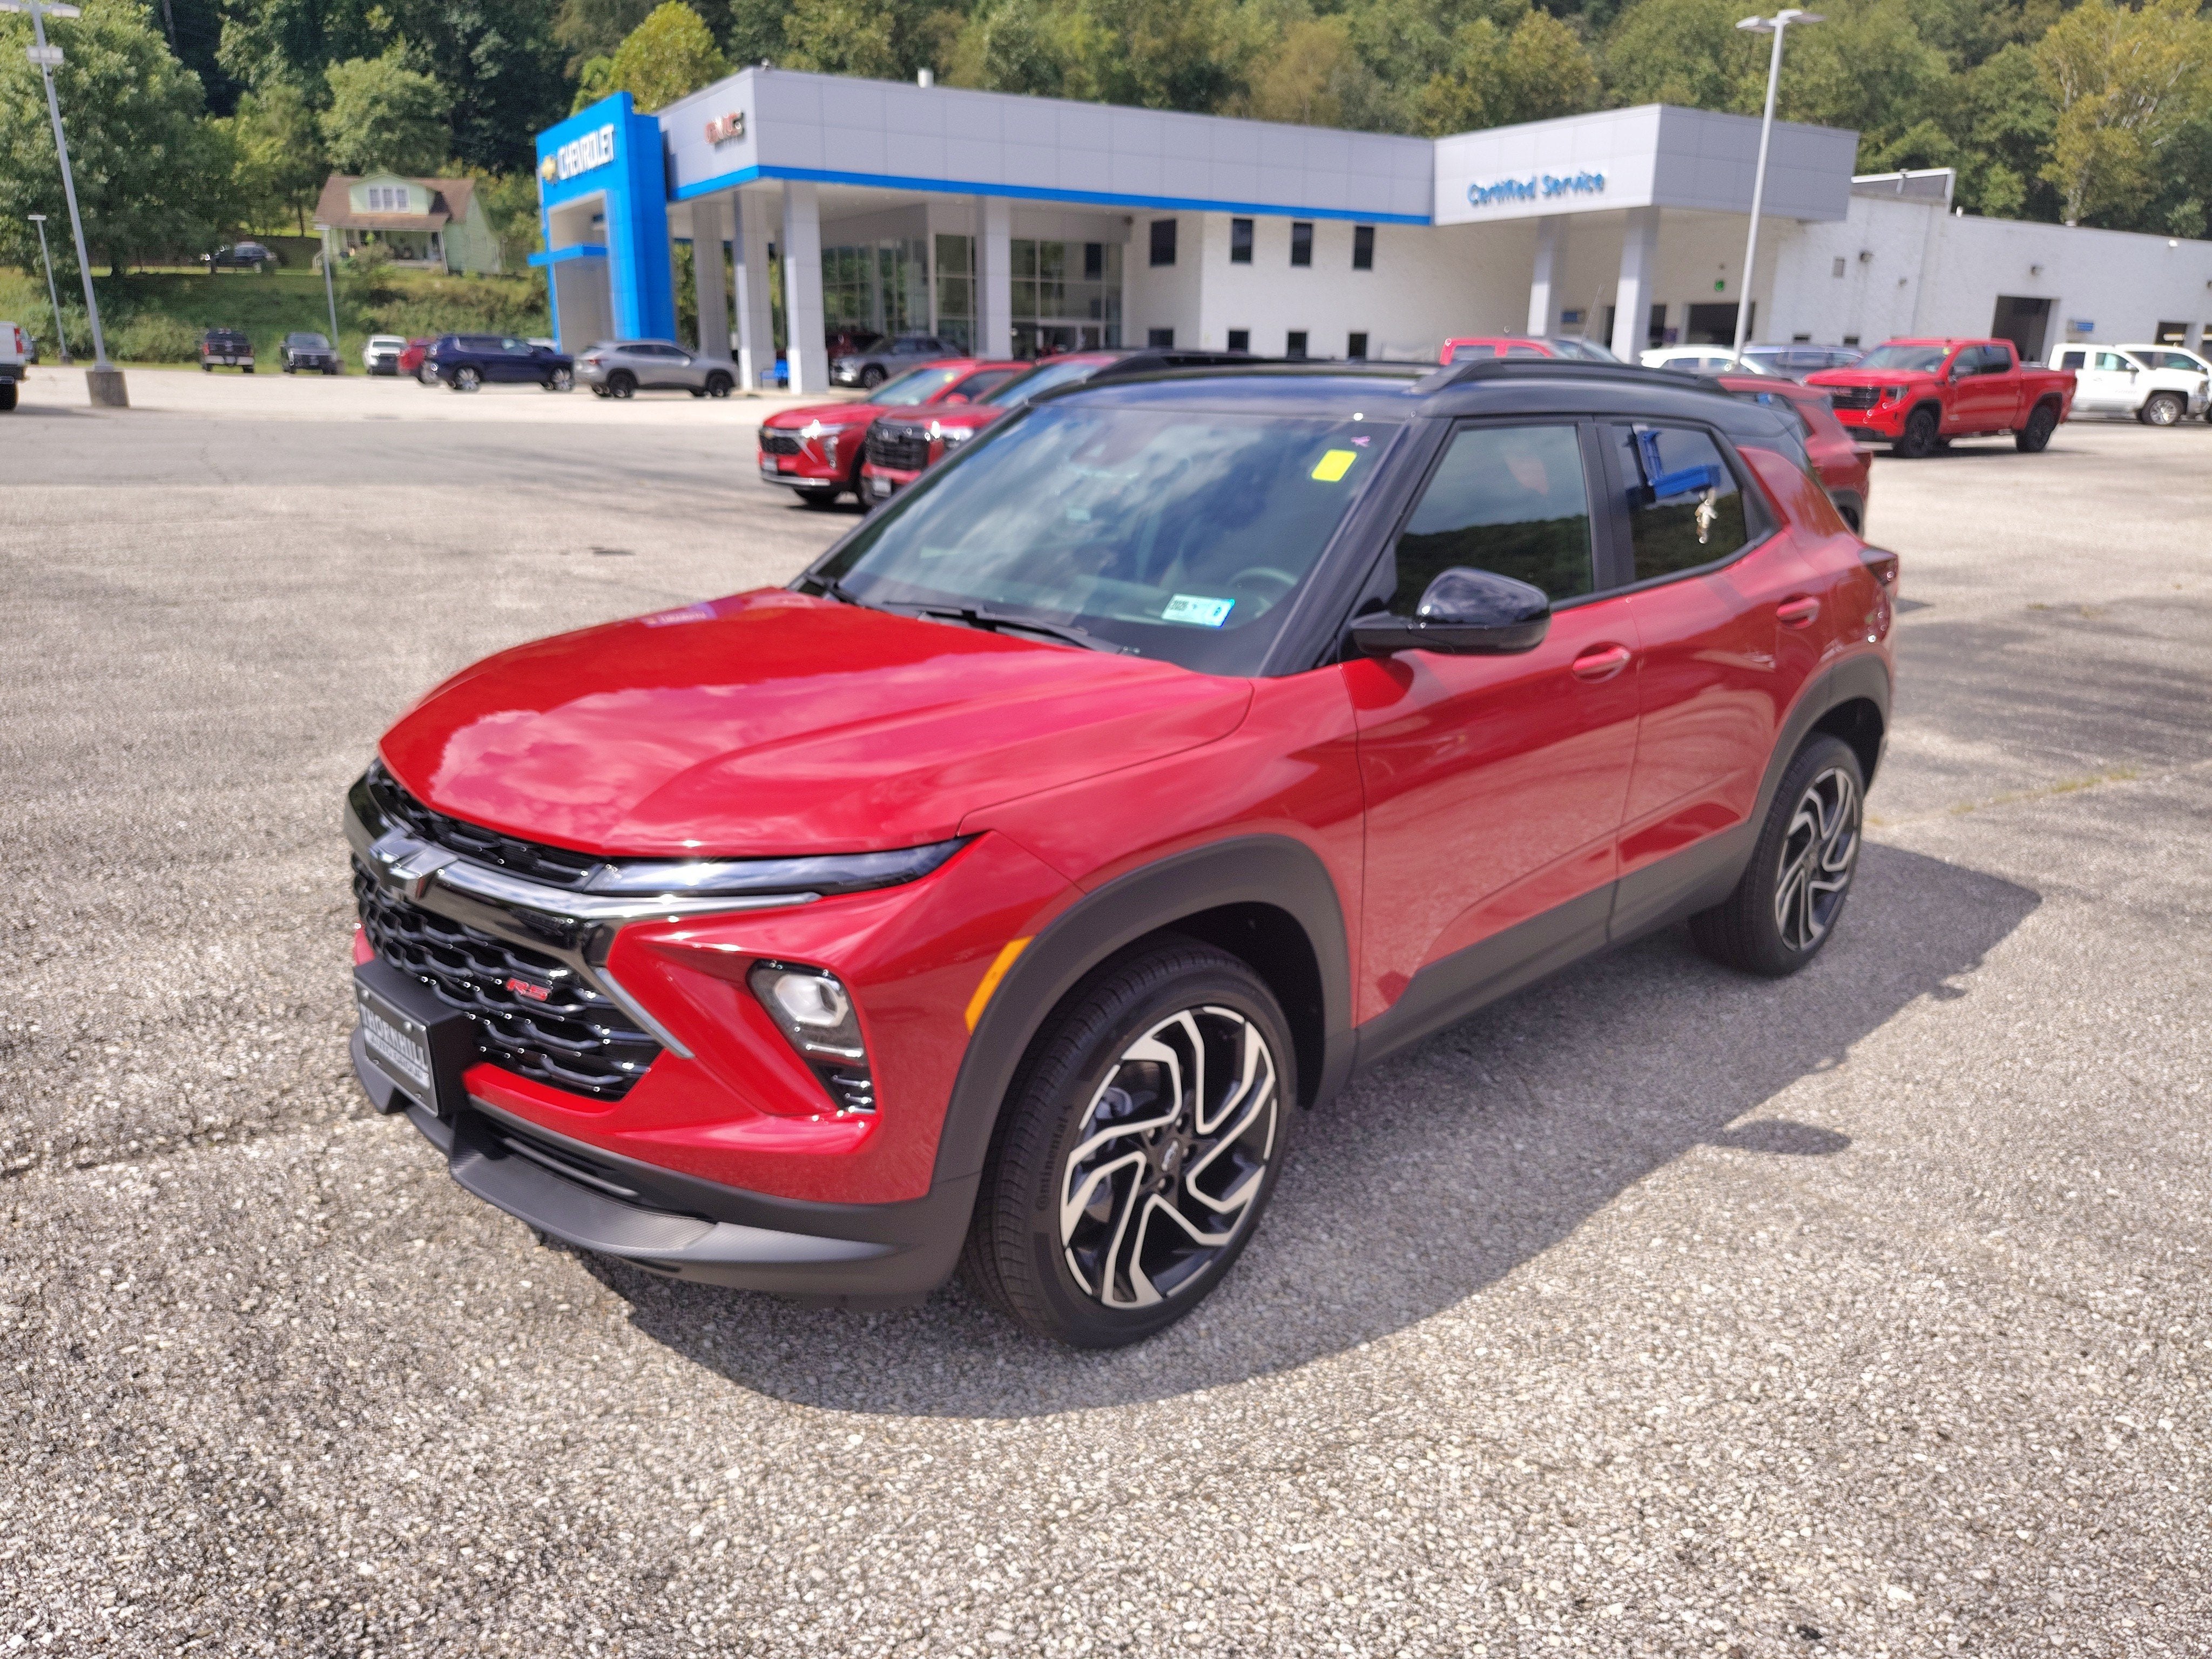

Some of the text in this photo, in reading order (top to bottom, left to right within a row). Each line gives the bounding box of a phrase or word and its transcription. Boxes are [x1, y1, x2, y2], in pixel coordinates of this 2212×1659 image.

[558, 123, 614, 180] CHEVROLET
[1467, 171, 1604, 204] Certified Service
[506, 977, 551, 1002] RS
[359, 1002, 429, 1072] THORNHILL
